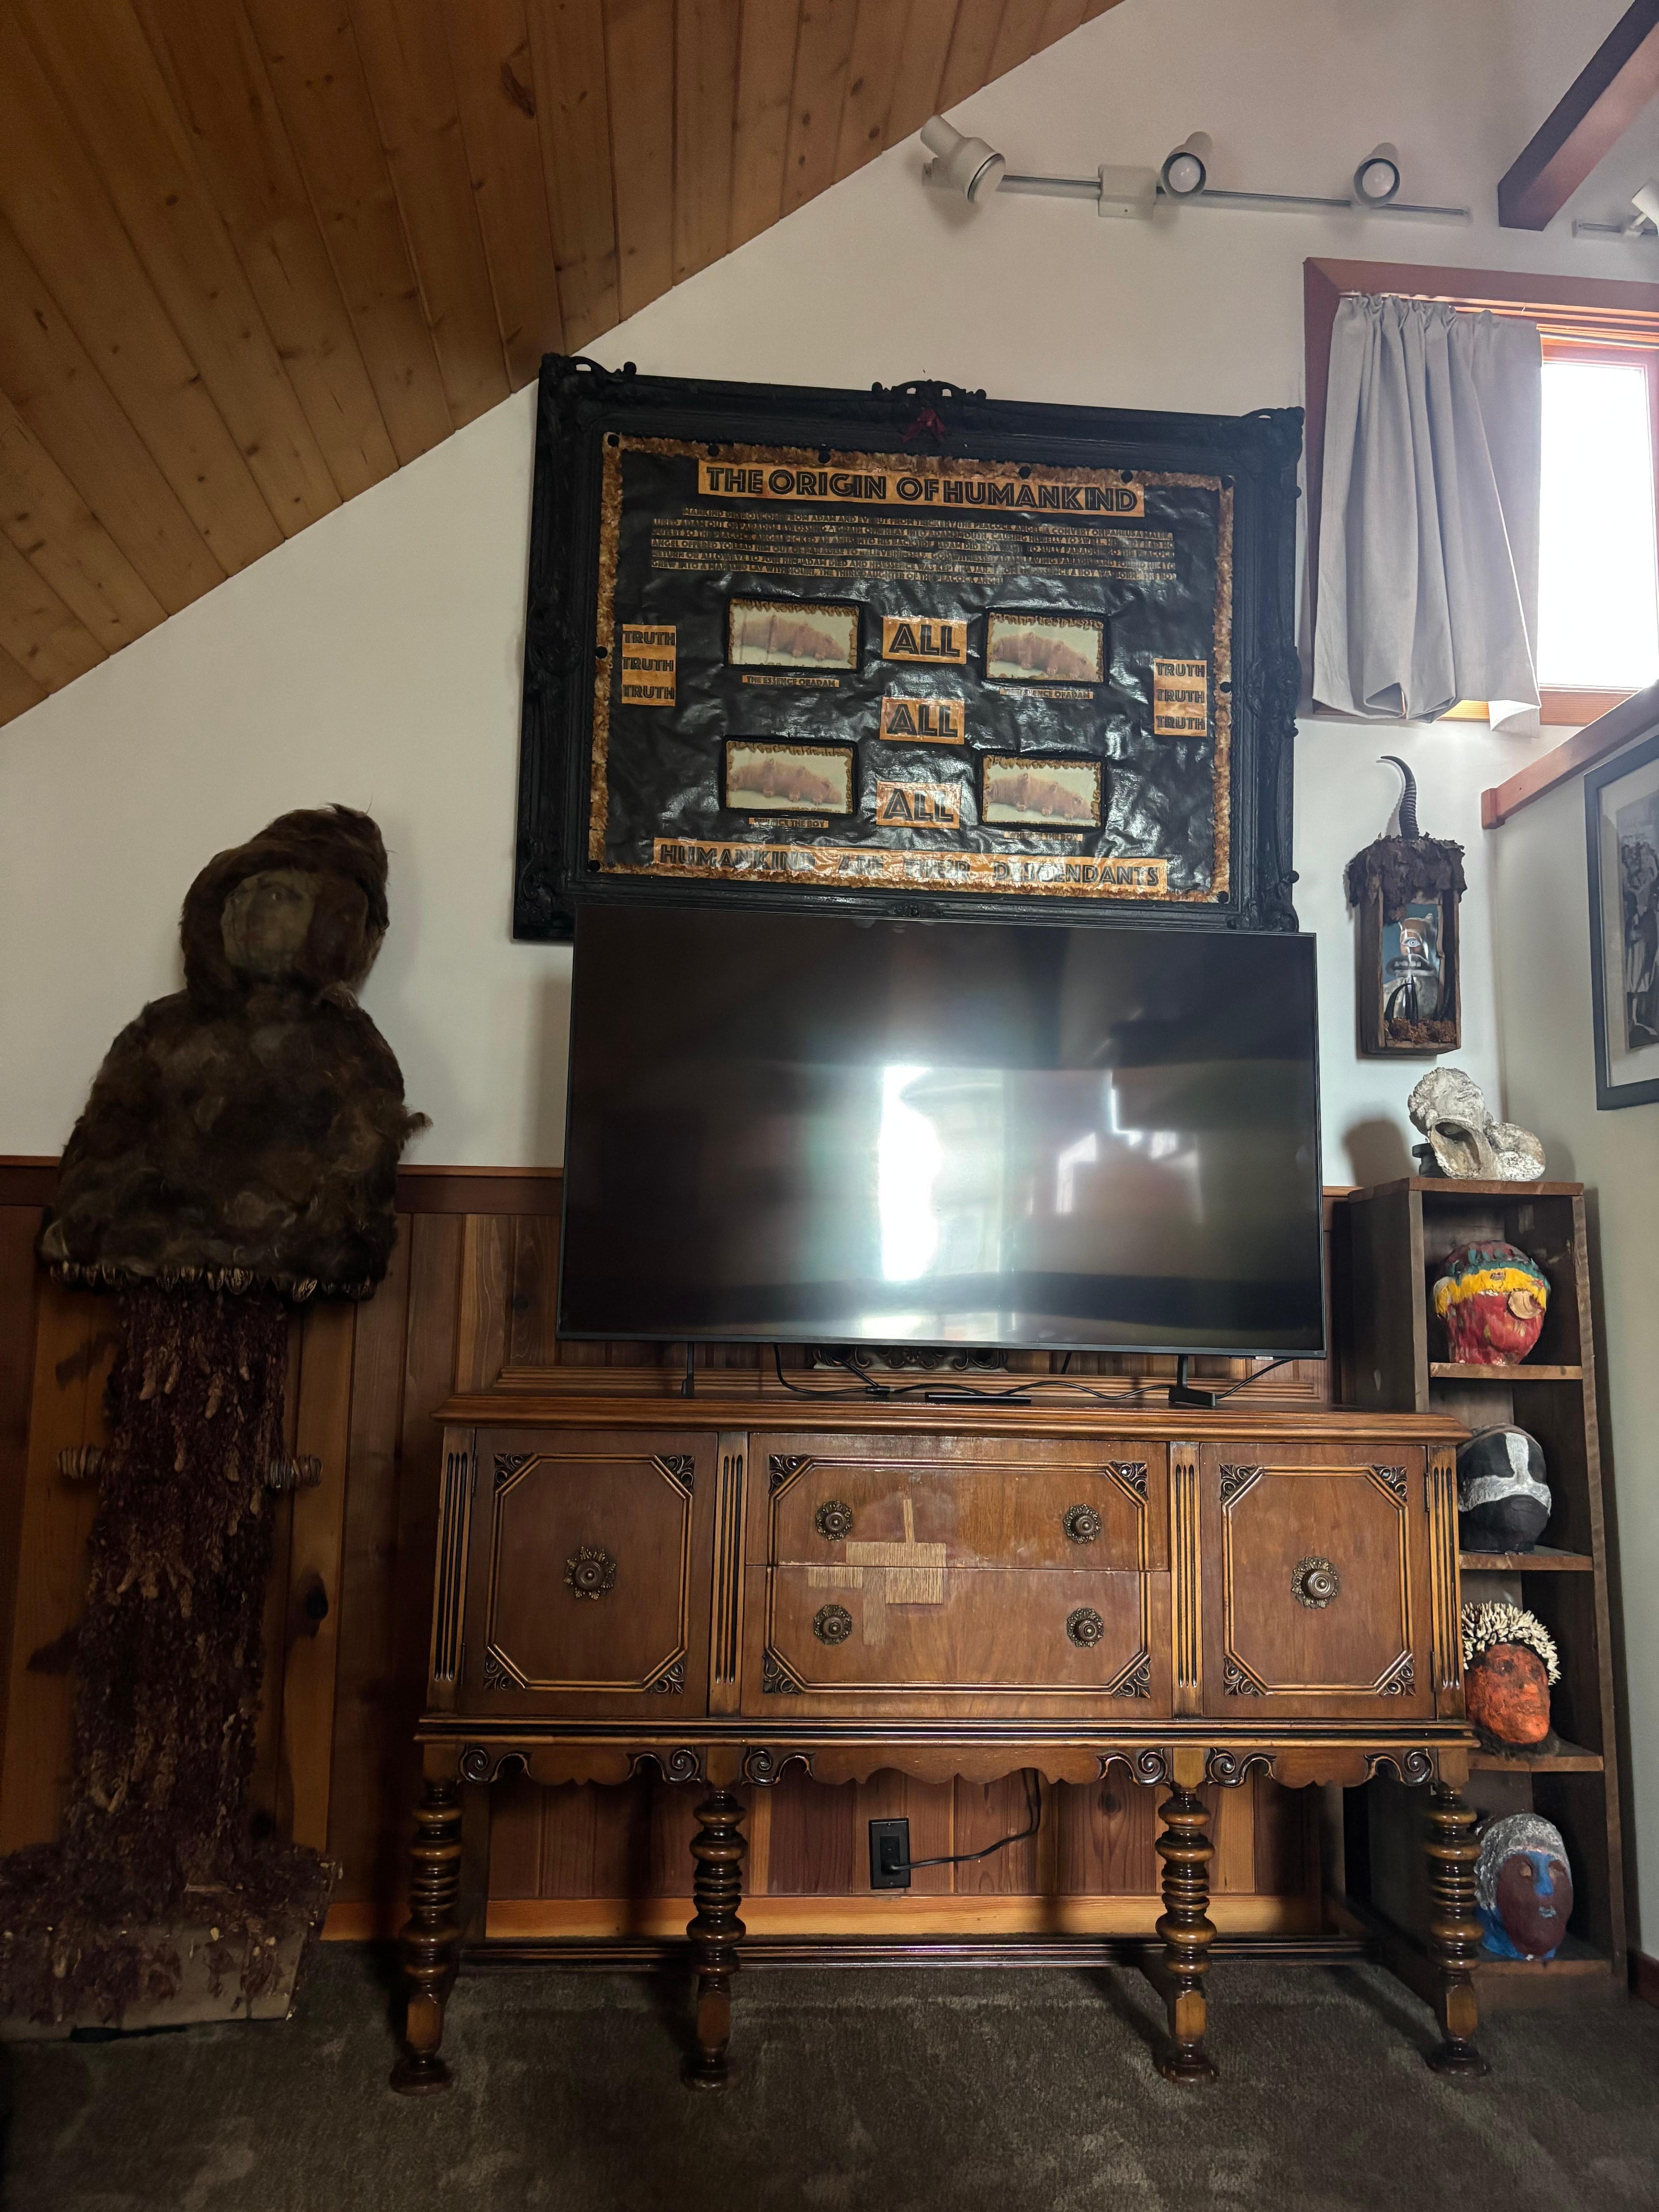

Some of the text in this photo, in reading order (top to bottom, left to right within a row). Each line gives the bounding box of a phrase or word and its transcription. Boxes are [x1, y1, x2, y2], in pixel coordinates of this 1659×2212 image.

[707, 466, 1138, 512] THE ORIGIN OF HUMANKIND
[652, 539, 679, 547] ANGEL
[623, 630, 675, 646] TRUTH
[889, 623, 960, 658] ALL
[622, 657, 674, 672] TRUTH
[1156, 663, 1205, 677] TRUTH
[763, 677, 797, 685] ESSENCE
[623, 685, 675, 699] TRUTH
[1156, 689, 1205, 703] TRUTH
[887, 704, 958, 737] ALL
[1156, 715, 1205, 730] TRUTH
[882, 788, 954, 822] ALL
[660, 844, 814, 871] HUMANKIND
[837, 855, 885, 876] ARE
[993, 861, 1159, 886] DSCENDANTS
